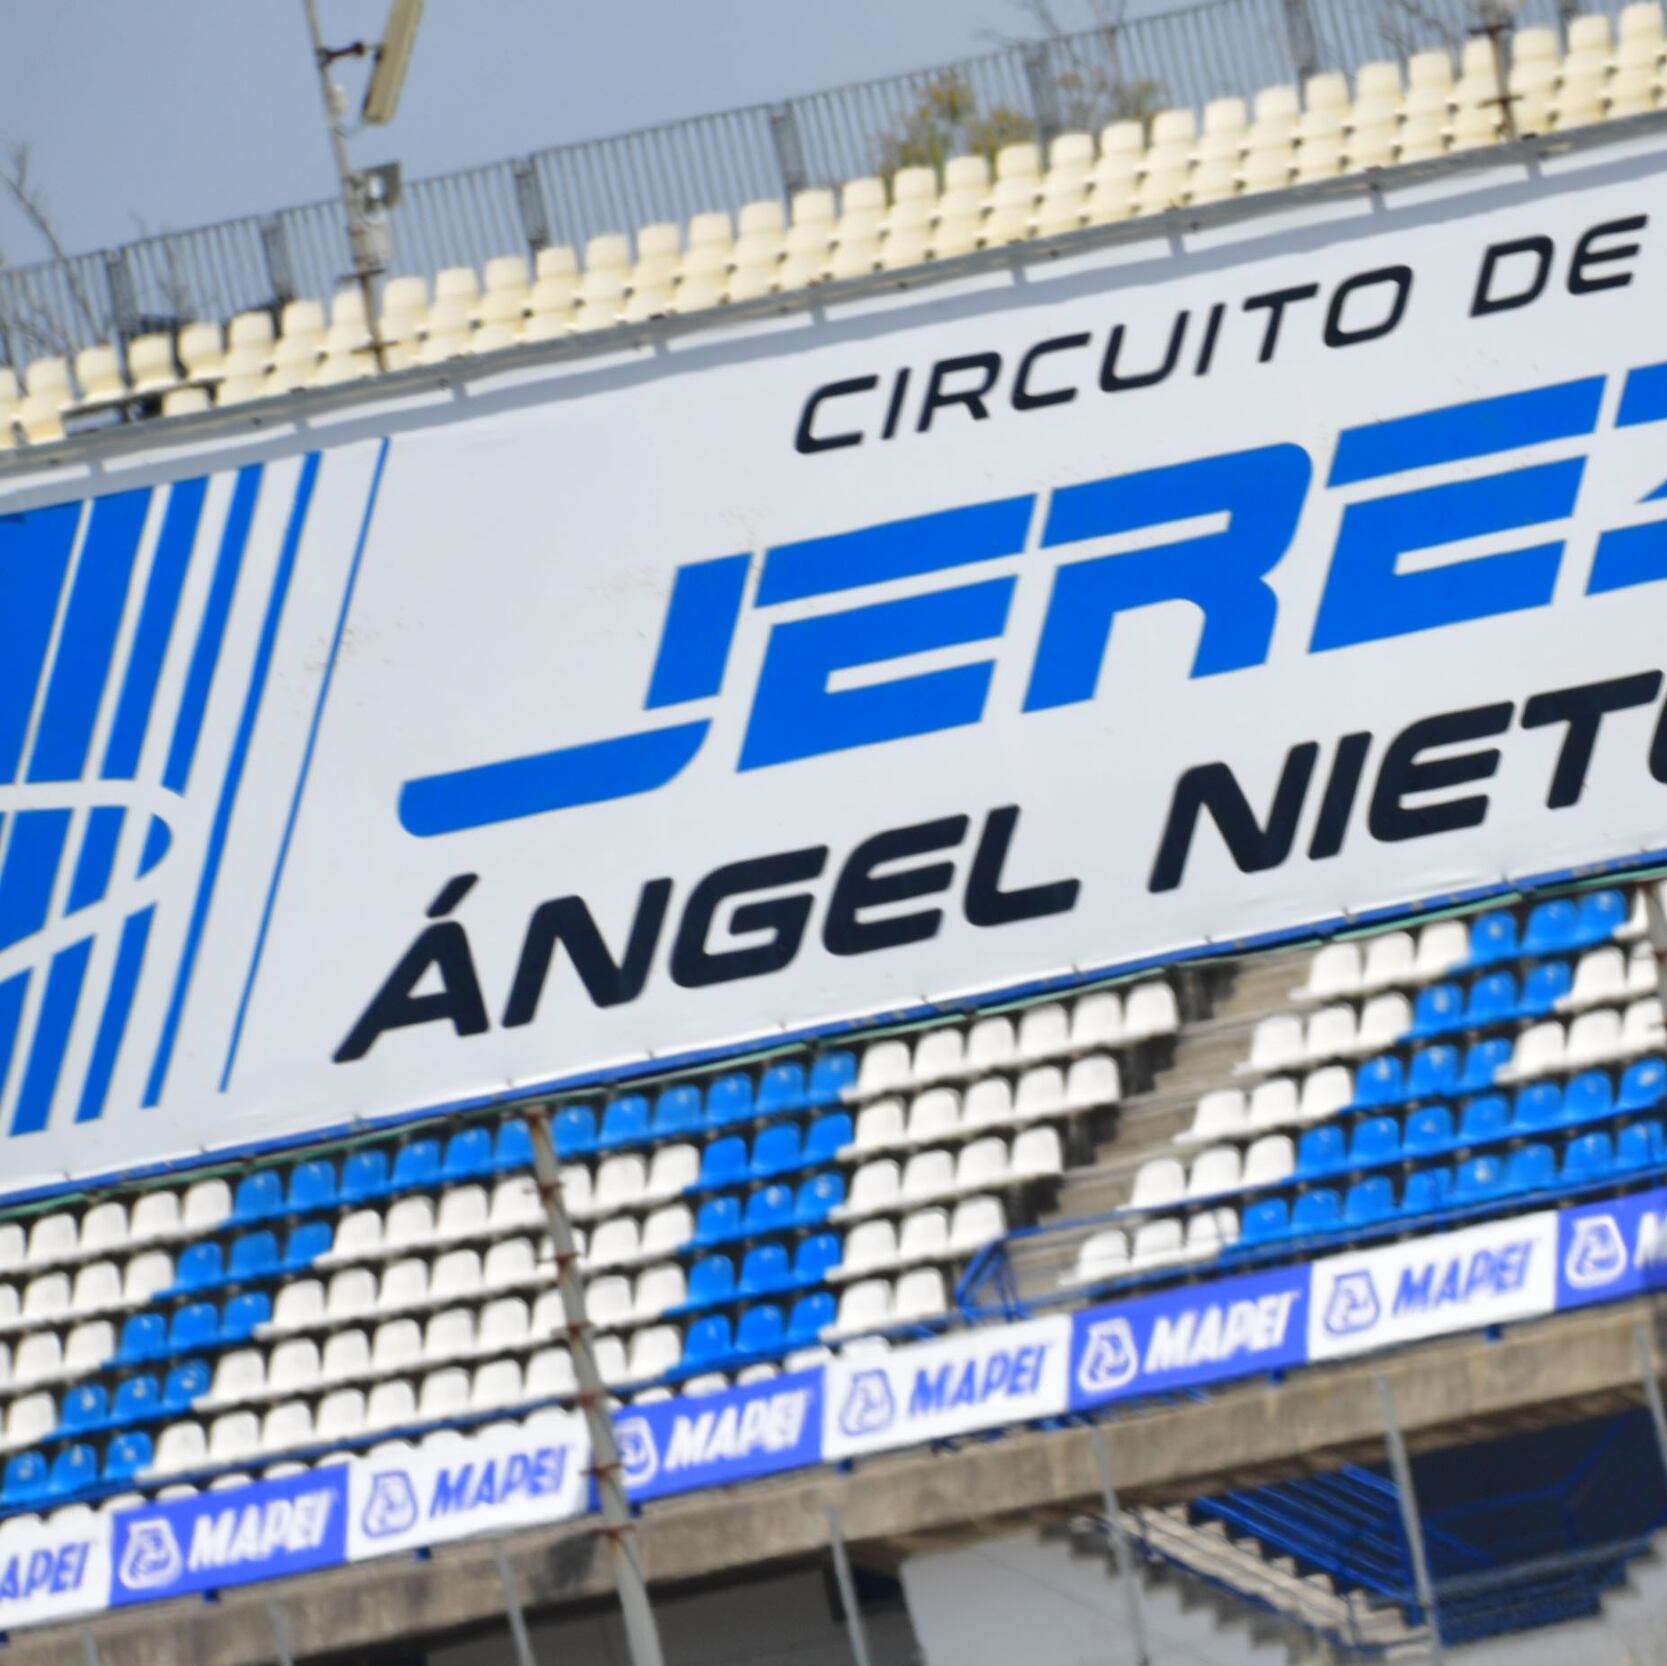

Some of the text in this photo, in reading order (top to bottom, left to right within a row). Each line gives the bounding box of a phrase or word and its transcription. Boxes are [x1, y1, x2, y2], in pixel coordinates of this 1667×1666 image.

[796, 215, 1647, 454] CIRCUITO DE
[335, 806, 1079, 1062] ÁNGEL
[1393, 1242, 1534, 1318] MAPEI
[1144, 1291, 1297, 1373] MAPEI
[906, 1345, 1047, 1414] MAPEI
[664, 1388, 812, 1470] MAPEI
[429, 1444, 569, 1518] MAPEI
[189, 1491, 332, 1570] MAPEI
